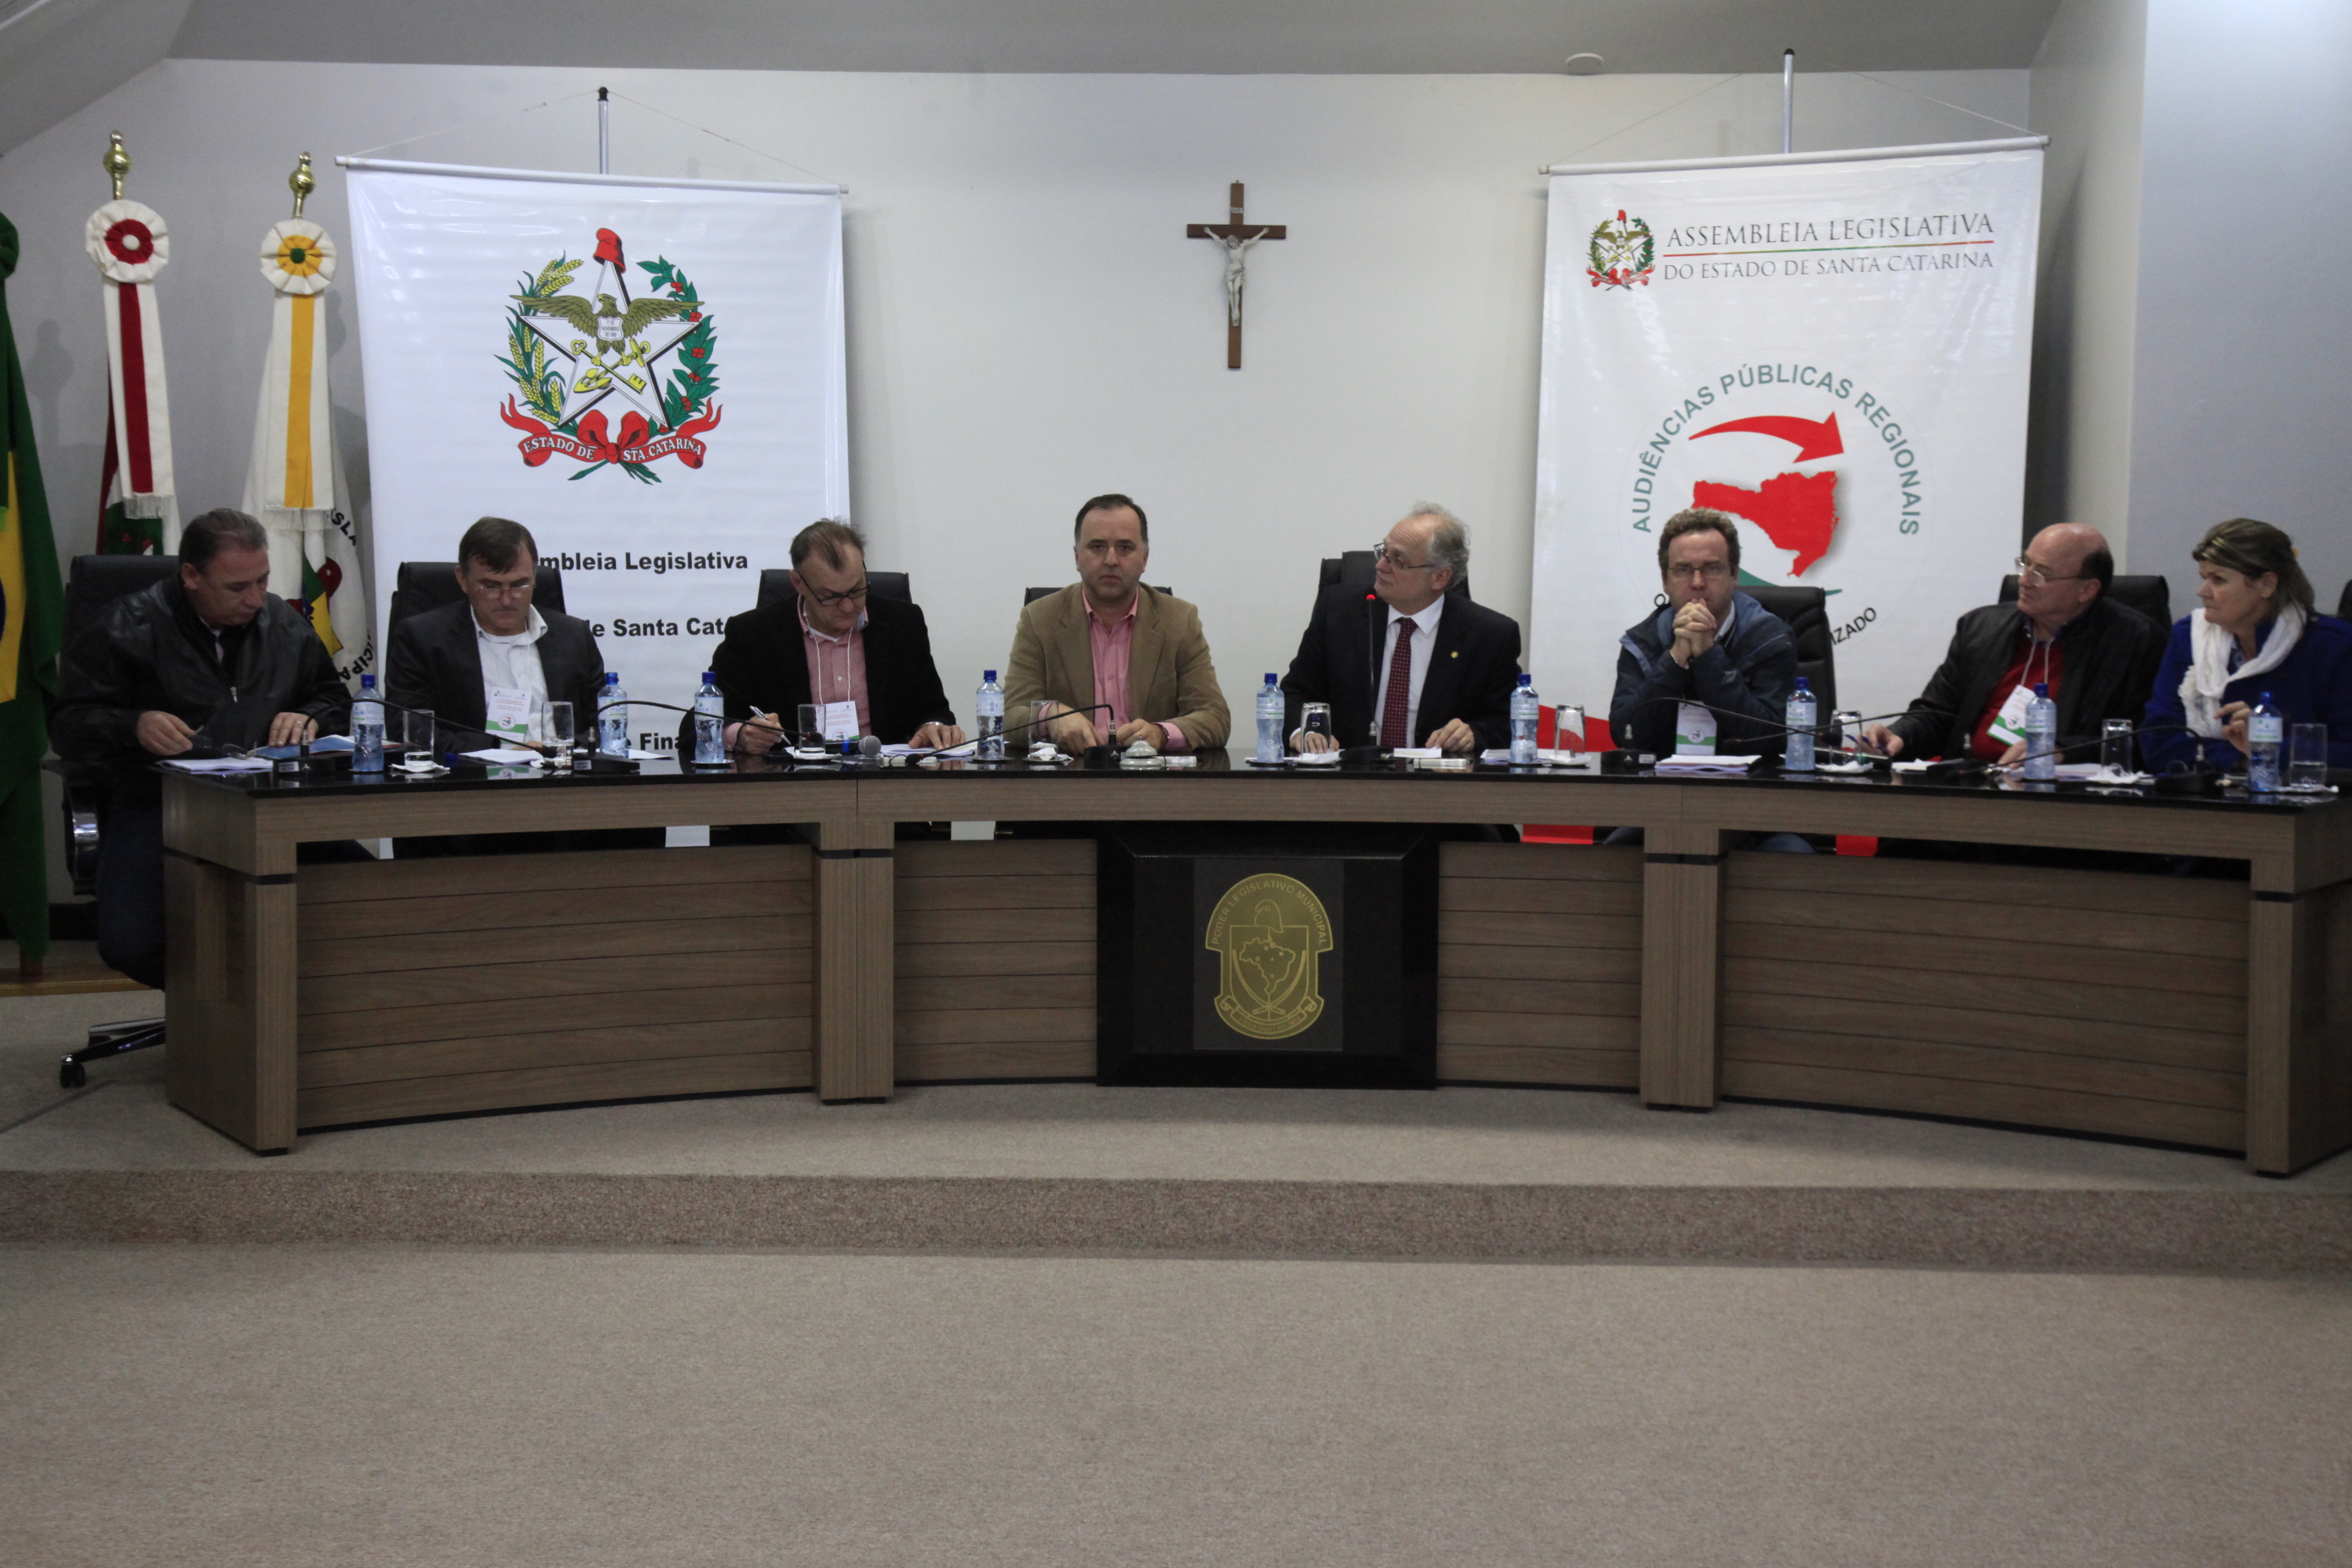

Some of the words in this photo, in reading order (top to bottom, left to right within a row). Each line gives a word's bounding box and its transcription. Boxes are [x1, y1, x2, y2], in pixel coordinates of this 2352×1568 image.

[1666, 221, 1819, 247] ASSEMBLEIA
[1828, 212, 1995, 241] LEGISLATIVA
[1664, 264, 1694, 280] DO
[1701, 260, 1776, 279] ESTADO
[1785, 259, 1810, 276] DE
[1816, 256, 1881, 275] SANTA
[1889, 252, 1994, 271] CATARINA
[522, 436, 575, 453] ESTADO
[576, 444, 595, 460] DE
[649, 437, 702, 458] CATARINA
[1632, 385, 1715, 533] AUDIÊNCIAS
[1719, 362, 1854, 399] PÚBLICAS
[1854, 390, 1922, 536] REGIONAIS
[540, 552, 617, 570] mbleia
[625, 552, 749, 574] Legislativa
[612, 618, 678, 637] Santa
[686, 618, 724, 636] Cat
[1830, 607, 1877, 645] IZADO
[1211, 906, 1231, 945] PODER
[1228, 879, 1295, 907] LEGISLATIVO
[1296, 890, 1327, 946] MUNICIPAL
